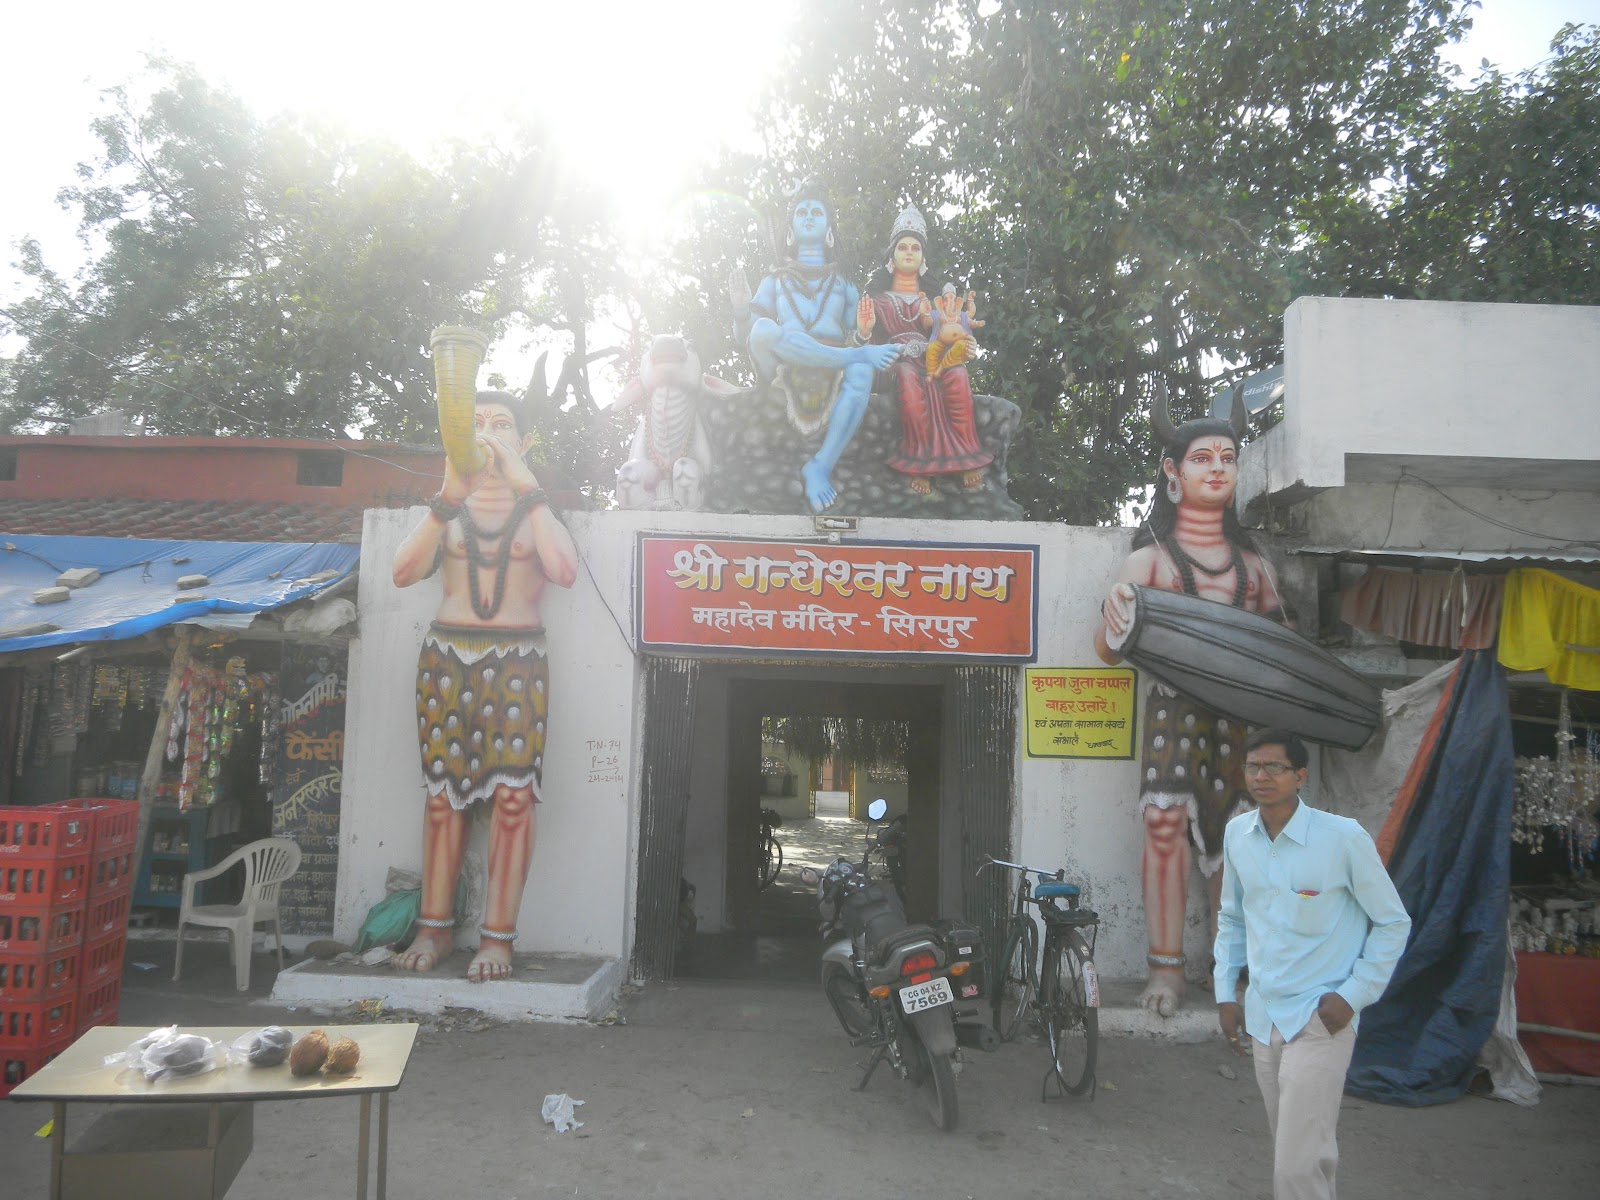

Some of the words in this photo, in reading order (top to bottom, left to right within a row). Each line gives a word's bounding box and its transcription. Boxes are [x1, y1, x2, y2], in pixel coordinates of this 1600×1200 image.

[665, 543, 728, 592] श्री
[732, 549, 914, 599] गन्धेश्वर
[917, 562, 1014, 602] नाथ
[691, 601, 778, 633] महादेव
[781, 603, 859, 637] मंदिर
[876, 605, 978, 649] सिरपुर
[1031, 676, 1067, 693] कृपया
[1096, 677, 1132, 693] चप्पल
[1045, 699, 1077, 714] बाहर
[1034, 716, 1048, 728] एवं
[1049, 719, 1073, 729] अपना
[1074, 719, 1103, 730] सामान
[1104, 717, 1127, 730] स्वयं
[906, 991, 948, 1011] 7569
[907, 990, 920, 999] CG
[920, 986, 930, 996] 04
